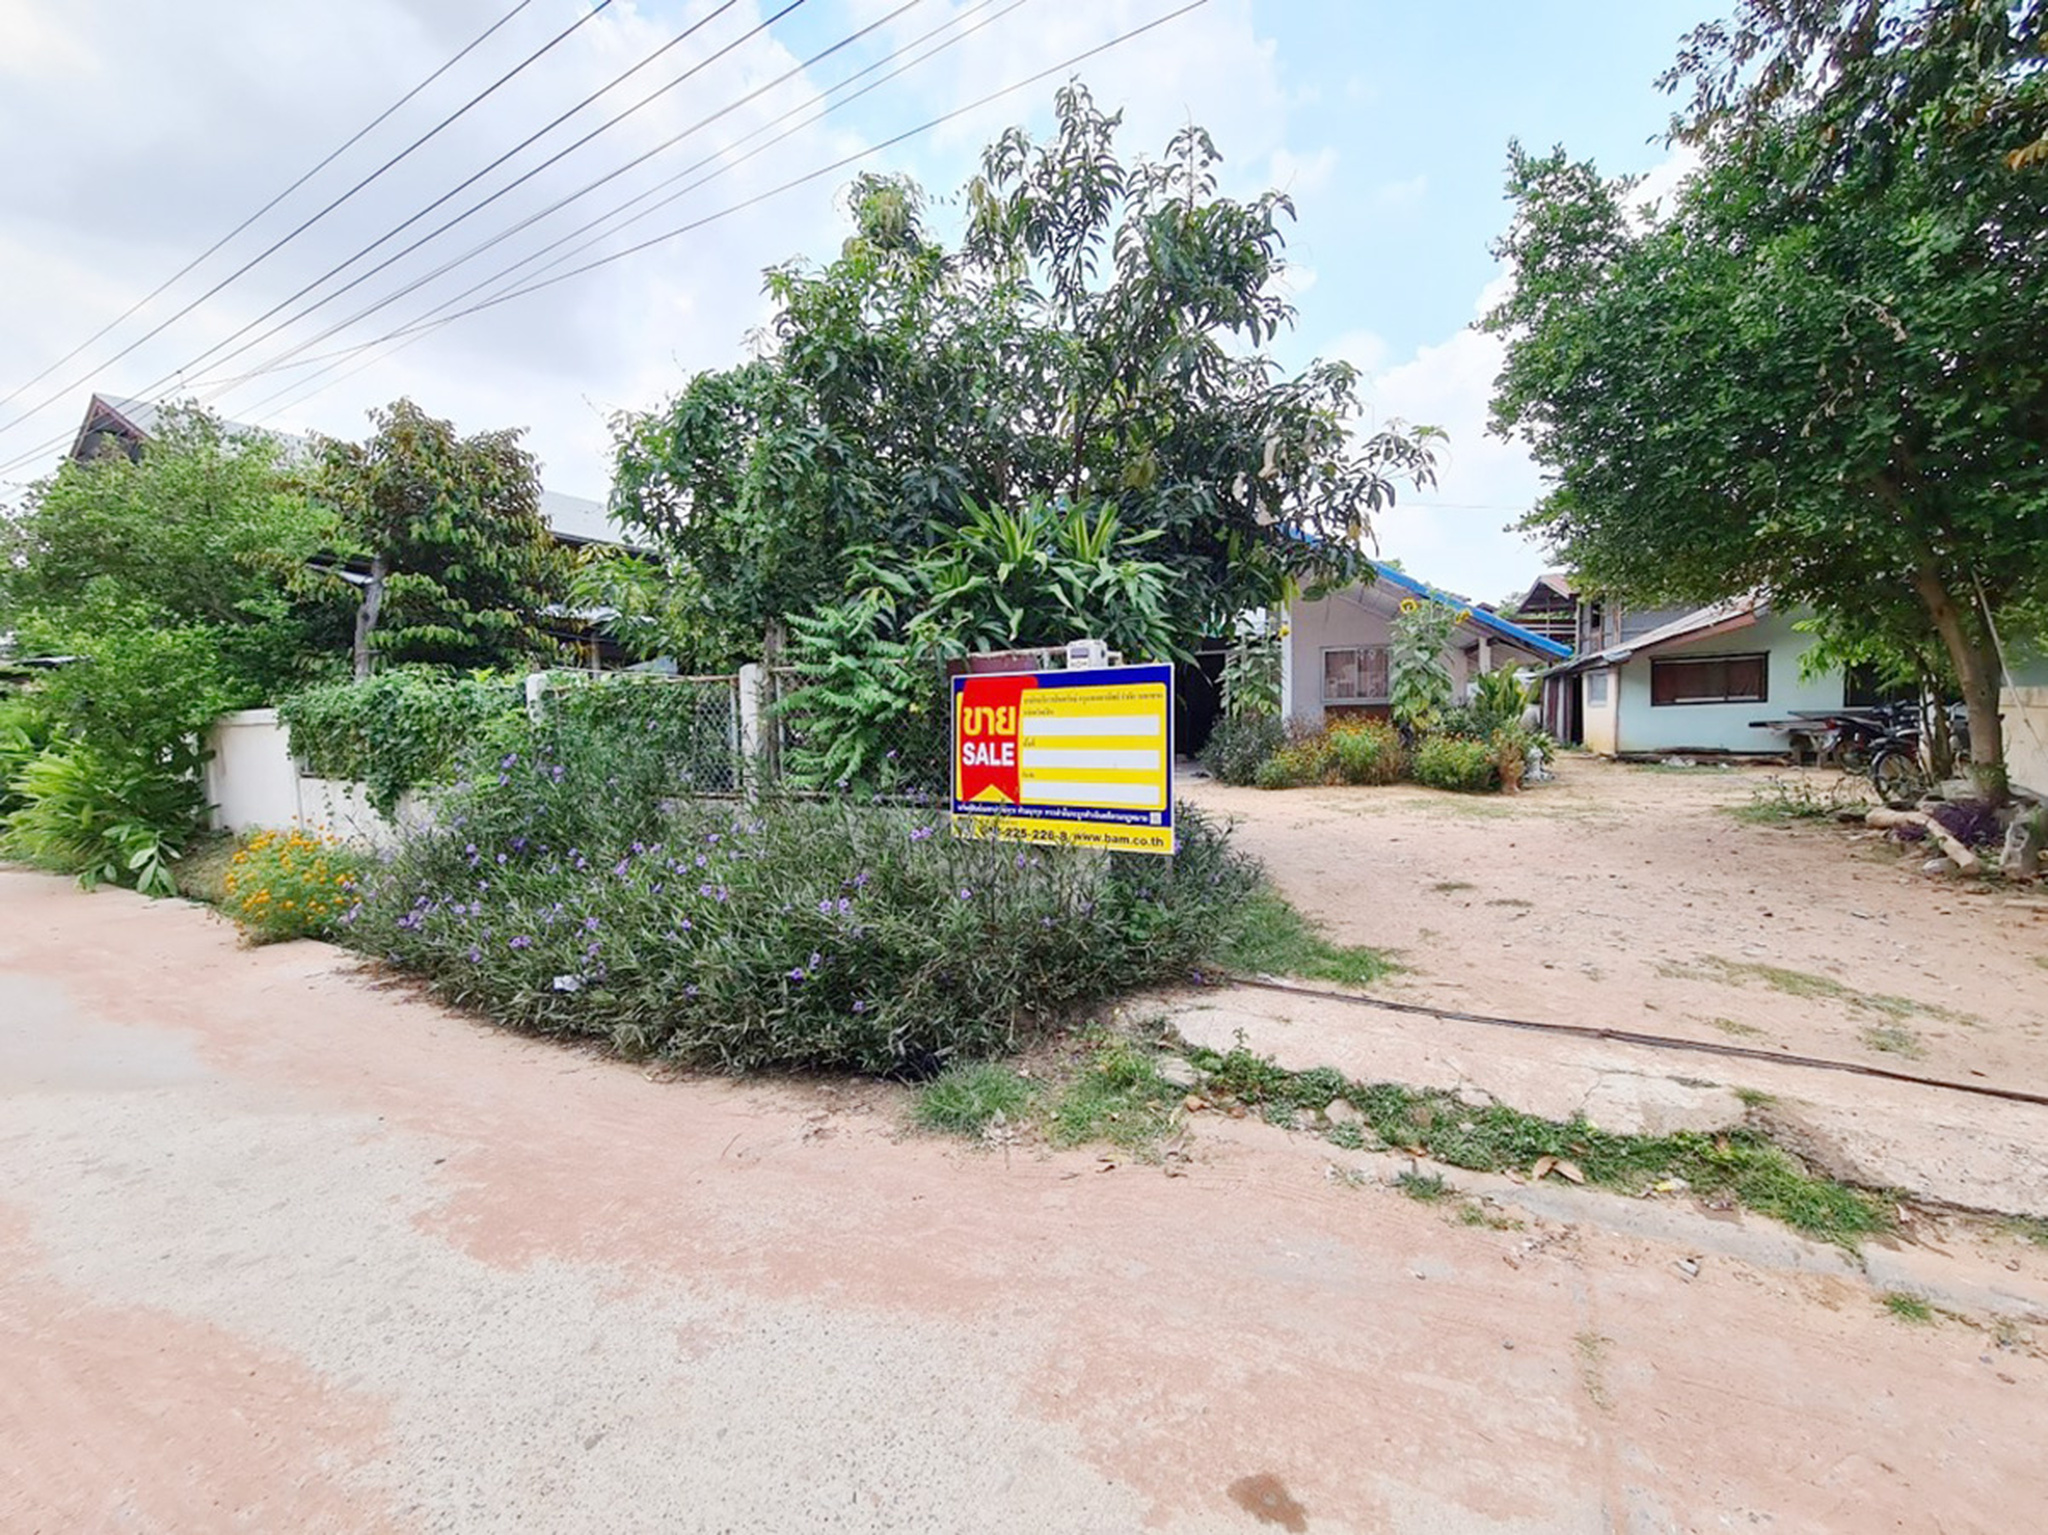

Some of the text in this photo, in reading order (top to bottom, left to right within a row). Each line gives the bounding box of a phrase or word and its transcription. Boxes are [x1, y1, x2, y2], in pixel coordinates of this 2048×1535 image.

[963, 705, 1016, 736] ขาย
[962, 742, 1015, 766] SALE
[1073, 830, 1164, 847] www.bam.co.th
